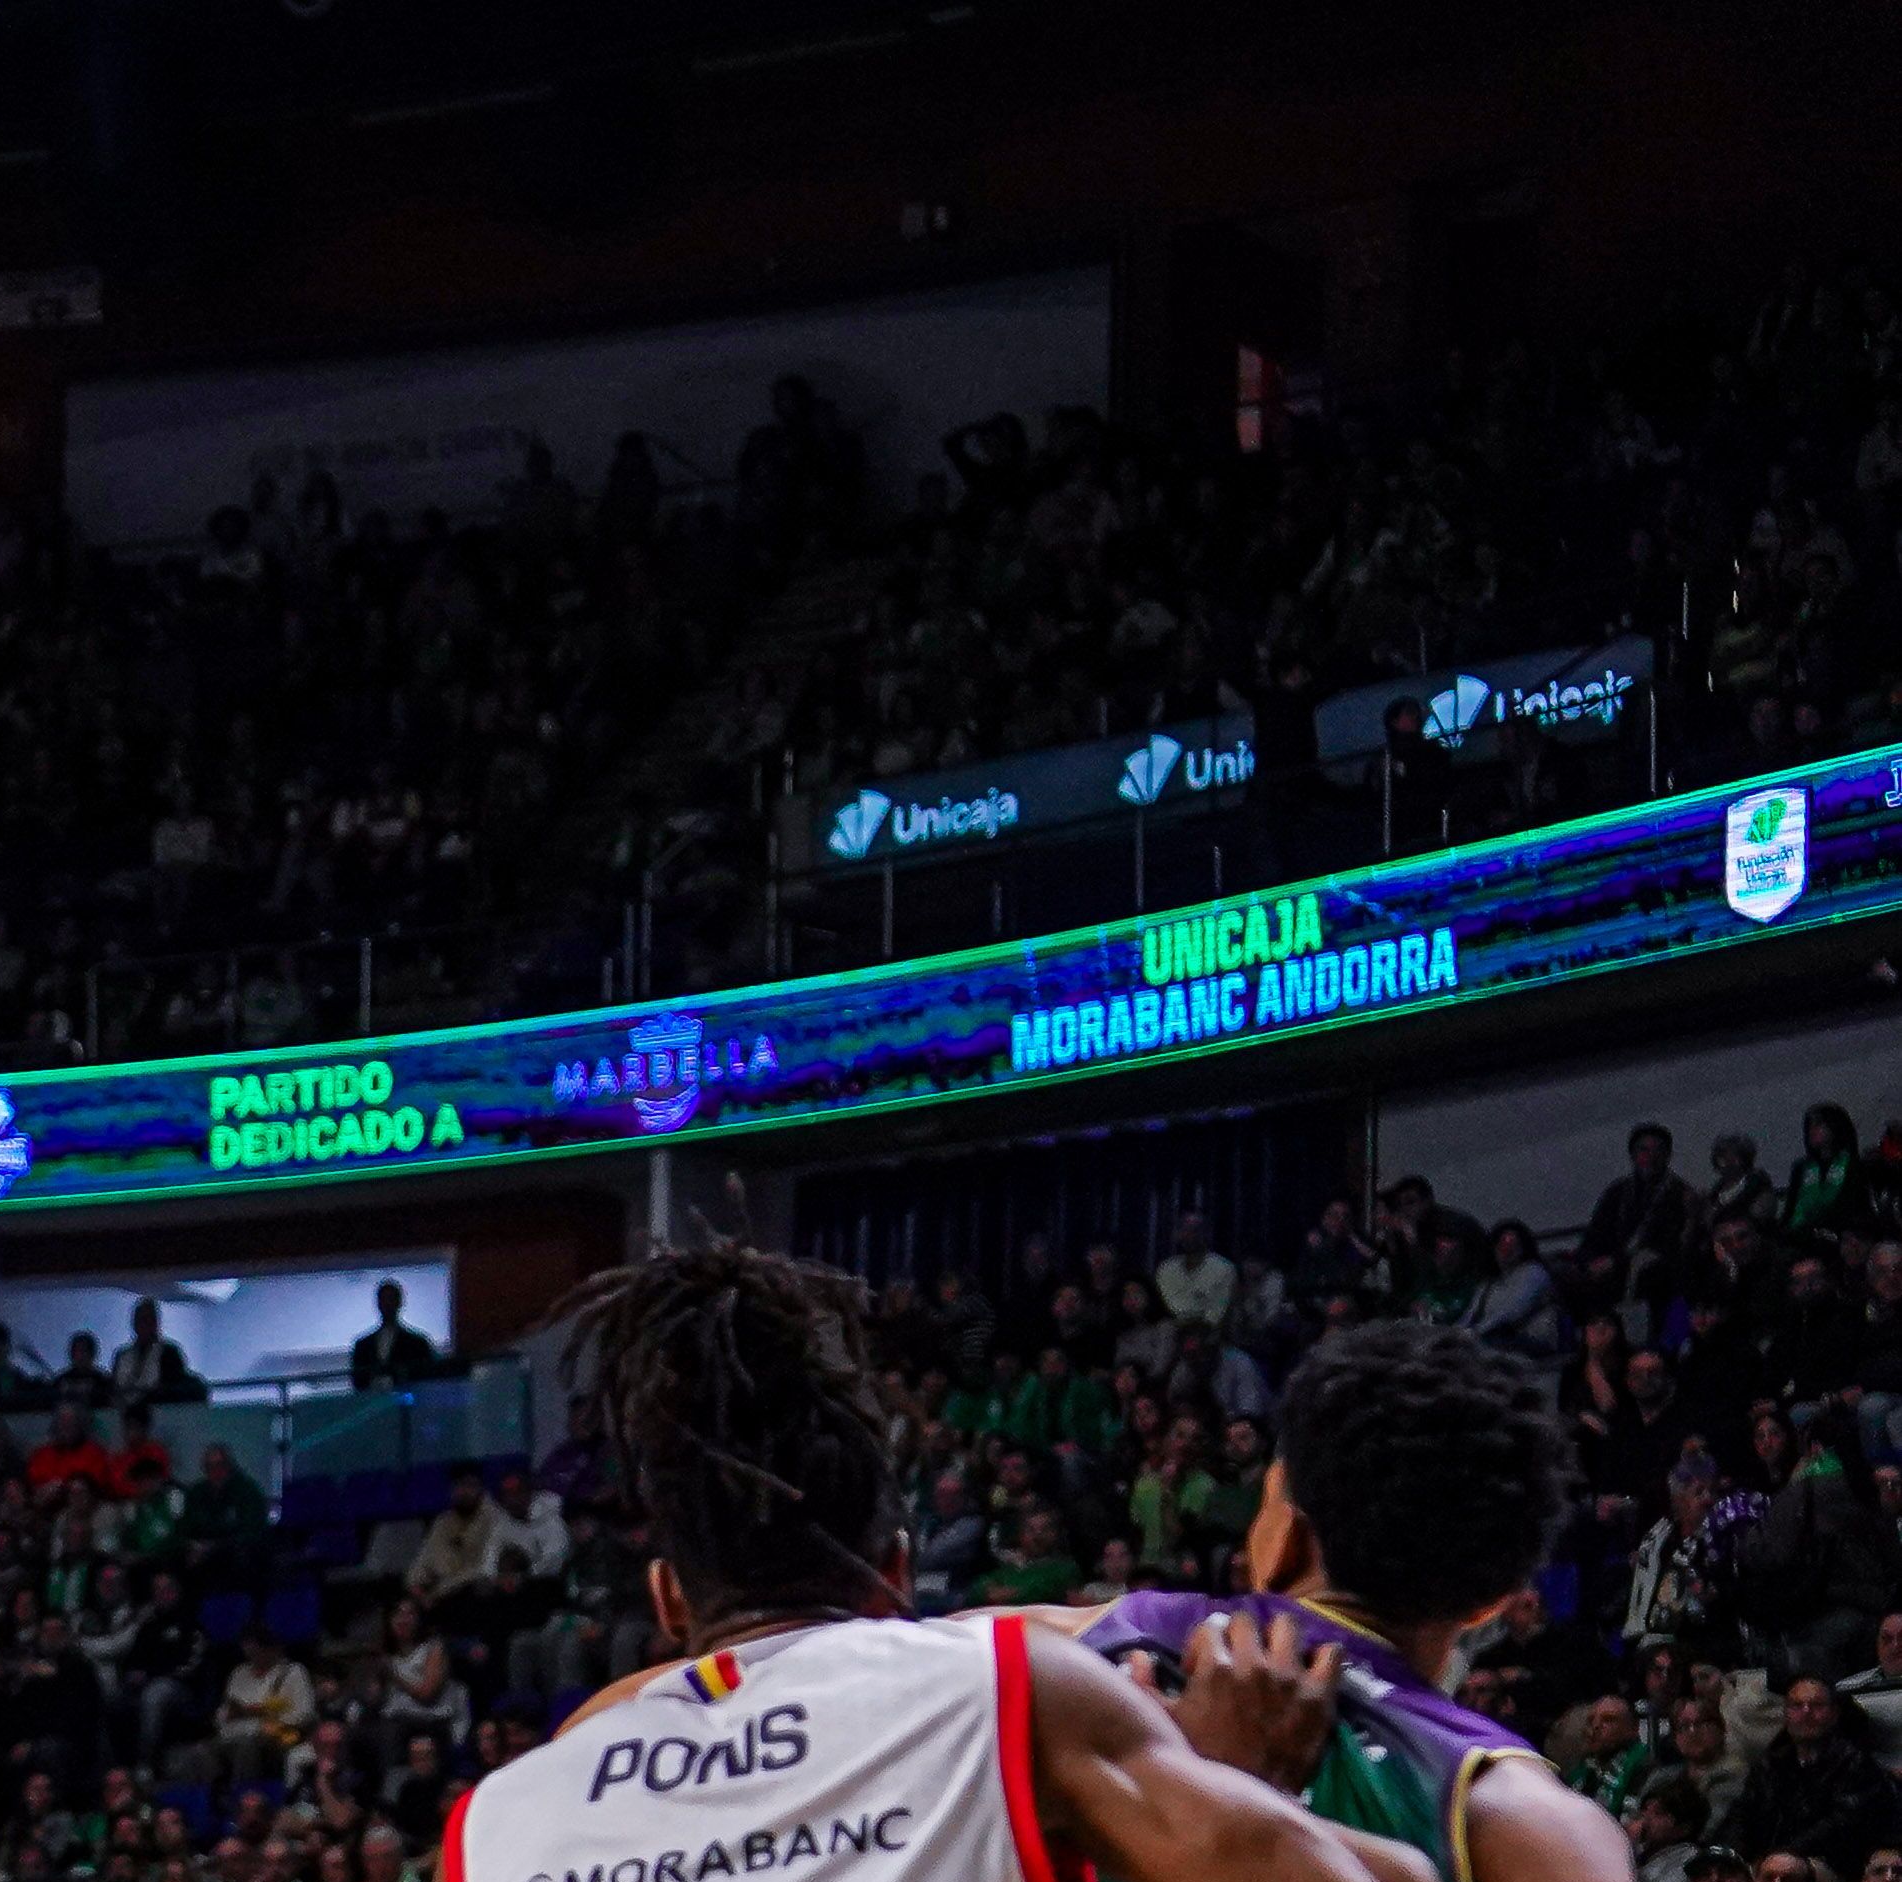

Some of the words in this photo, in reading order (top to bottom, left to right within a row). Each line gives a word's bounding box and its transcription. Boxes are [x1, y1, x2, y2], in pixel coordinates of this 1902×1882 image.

[894, 787, 1019, 845] Unicaja
[1142, 892, 1324, 986] UNICAJA
[1010, 971, 1248, 1073] MORABANC
[1255, 926, 1458, 1027] ANDORRA
[210, 1060, 394, 1121] PARTIDO
[551, 1033, 780, 1101] MARBELLA
[210, 1105, 425, 1172] DEDICADO
[429, 1102, 465, 1149] A
